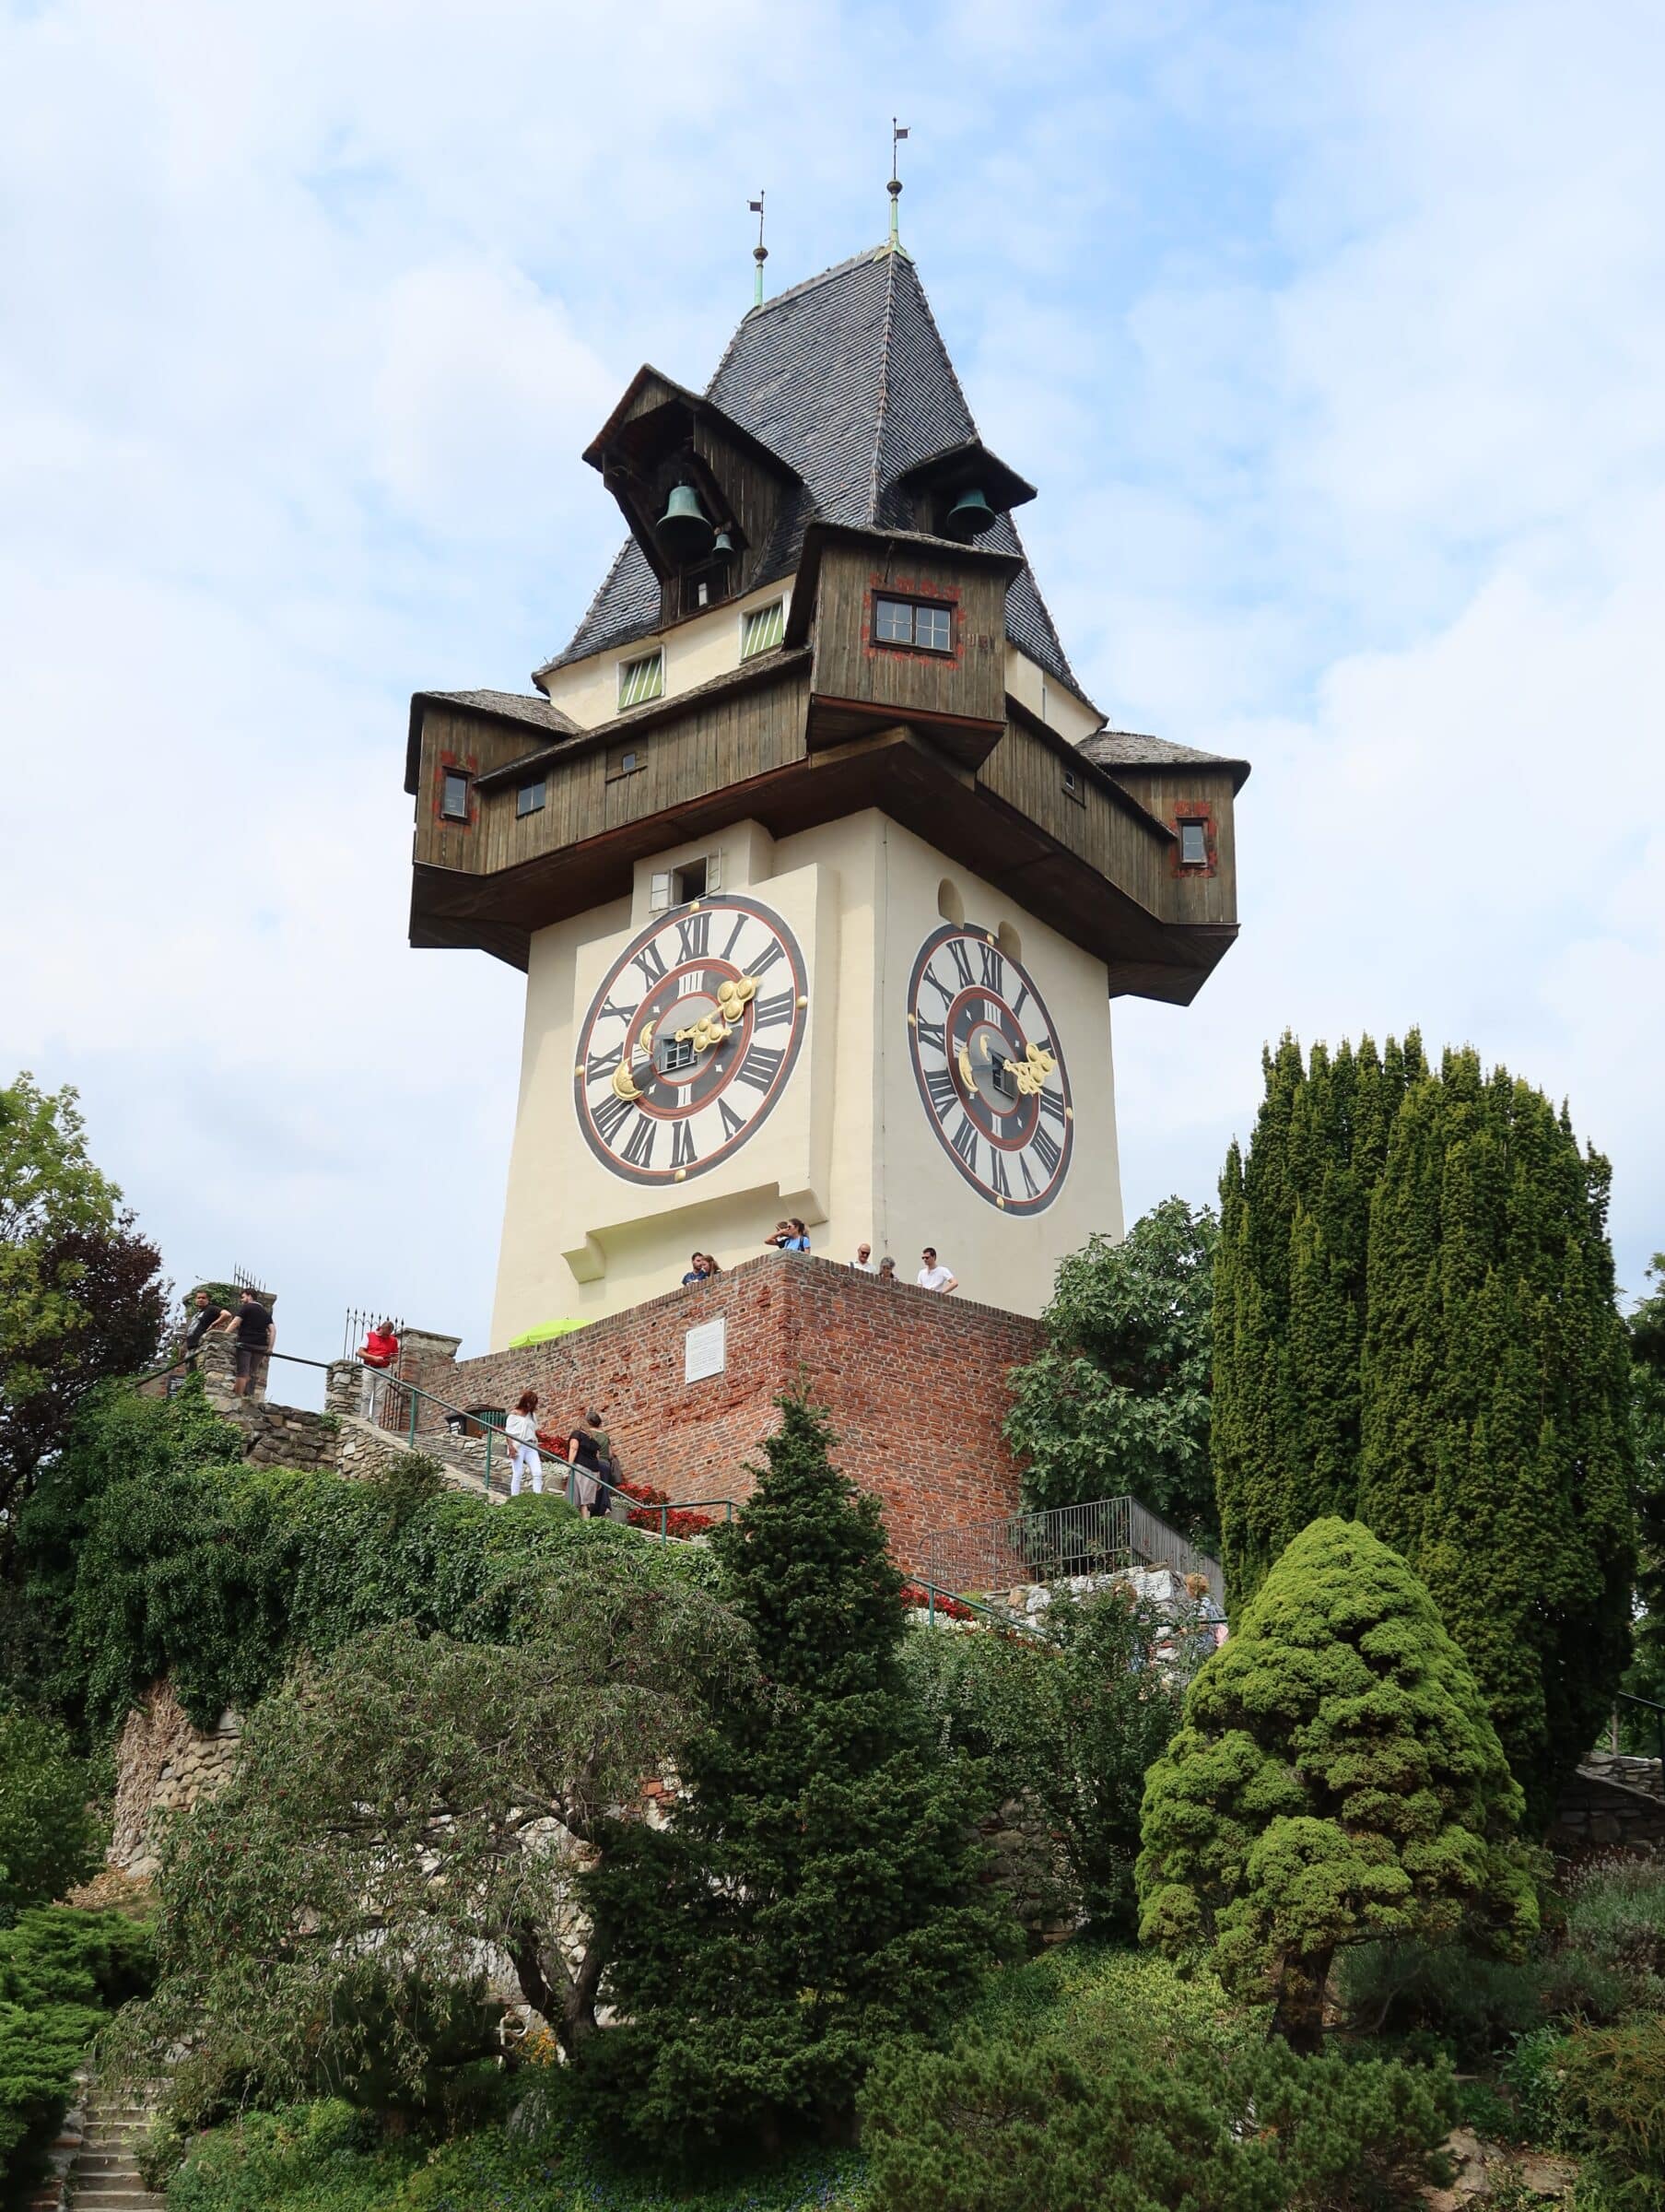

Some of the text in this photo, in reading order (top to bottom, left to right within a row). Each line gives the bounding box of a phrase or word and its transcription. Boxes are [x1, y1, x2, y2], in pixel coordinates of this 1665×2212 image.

[675, 912, 712, 966] XII
[721, 913, 749, 960] I
[743, 937, 786, 976] II
[630, 938, 669, 992] XI
[923, 962, 955, 1011] X
[947, 939, 975, 988] XI
[979, 942, 1003, 996] XII
[597, 996, 639, 1026] X
[754, 987, 794, 1032] III
[1014, 982, 1029, 1019] I
[918, 1008, 946, 1055] IX
[586, 1041, 625, 1086] IX
[734, 1042, 786, 1096] IIII
[591, 1091, 634, 1147] VIII
[717, 1098, 746, 1141] V
[923, 1067, 958, 1123] VIII
[1040, 1084, 1065, 1128] III
[621, 1113, 657, 1169] VII
[670, 1119, 698, 1169] VI
[951, 1112, 979, 1173] VII
[1029, 1121, 1062, 1180] IIII
[990, 1146, 1012, 1198] VI
[1019, 1151, 1040, 1198] V
